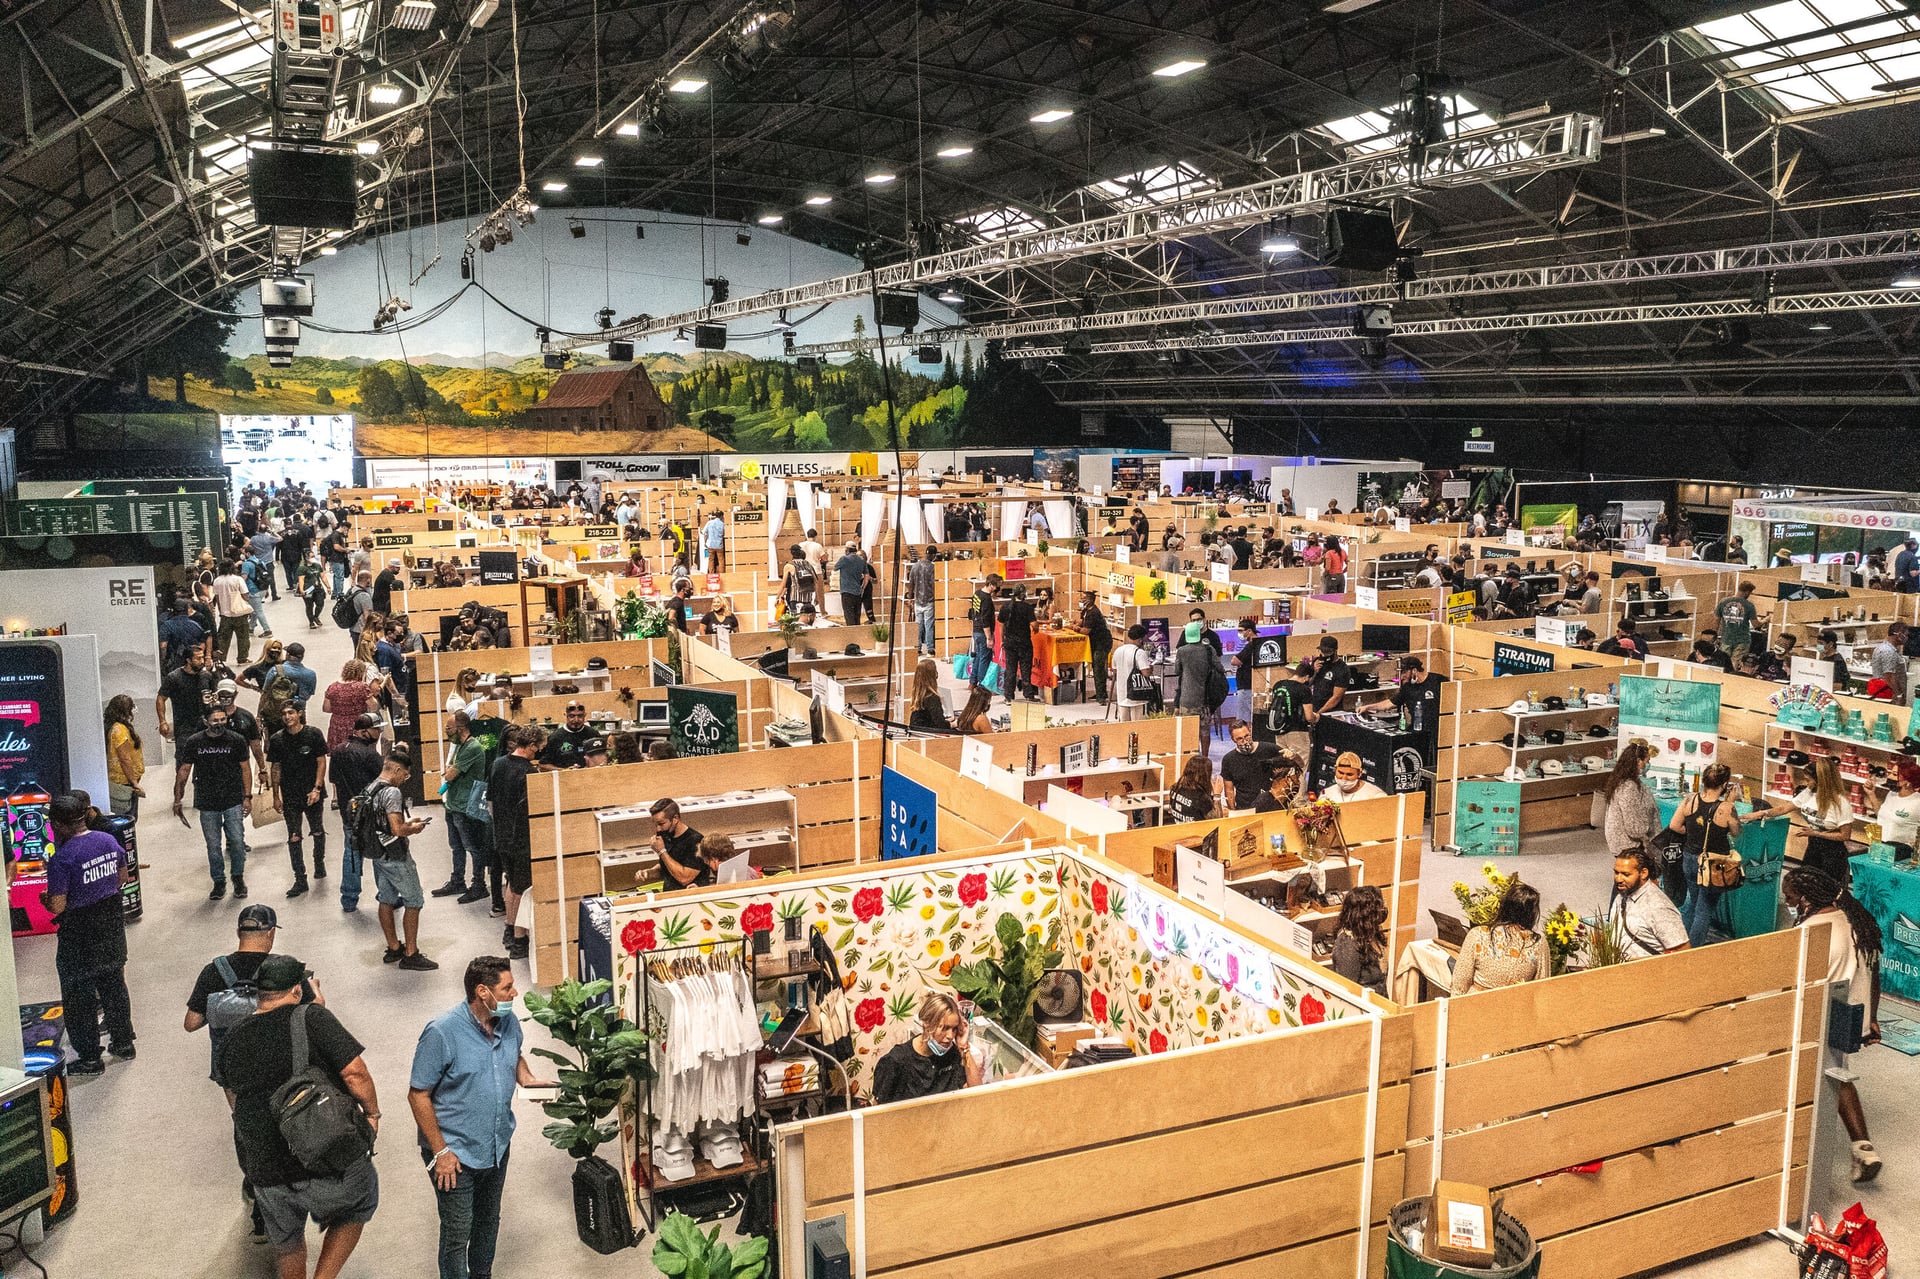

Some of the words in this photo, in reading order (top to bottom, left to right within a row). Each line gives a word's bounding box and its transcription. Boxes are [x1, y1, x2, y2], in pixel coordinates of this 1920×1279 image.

[595, 460, 624, 469] ROLL
[626, 464, 661, 473] GROW
[759, 463, 819, 475] TIMELESS
[381, 536, 408, 544] 119-129
[109, 578, 146, 598] RE
[110, 598, 146, 606] CREATE
[1498, 647, 1551, 668] STRATUM
[1497, 657, 1530, 670] BRANDS
[197, 746, 232, 755] RADIANT
[686, 744, 721, 755] CARTER'S
[82, 859, 119, 885] CULTURE
